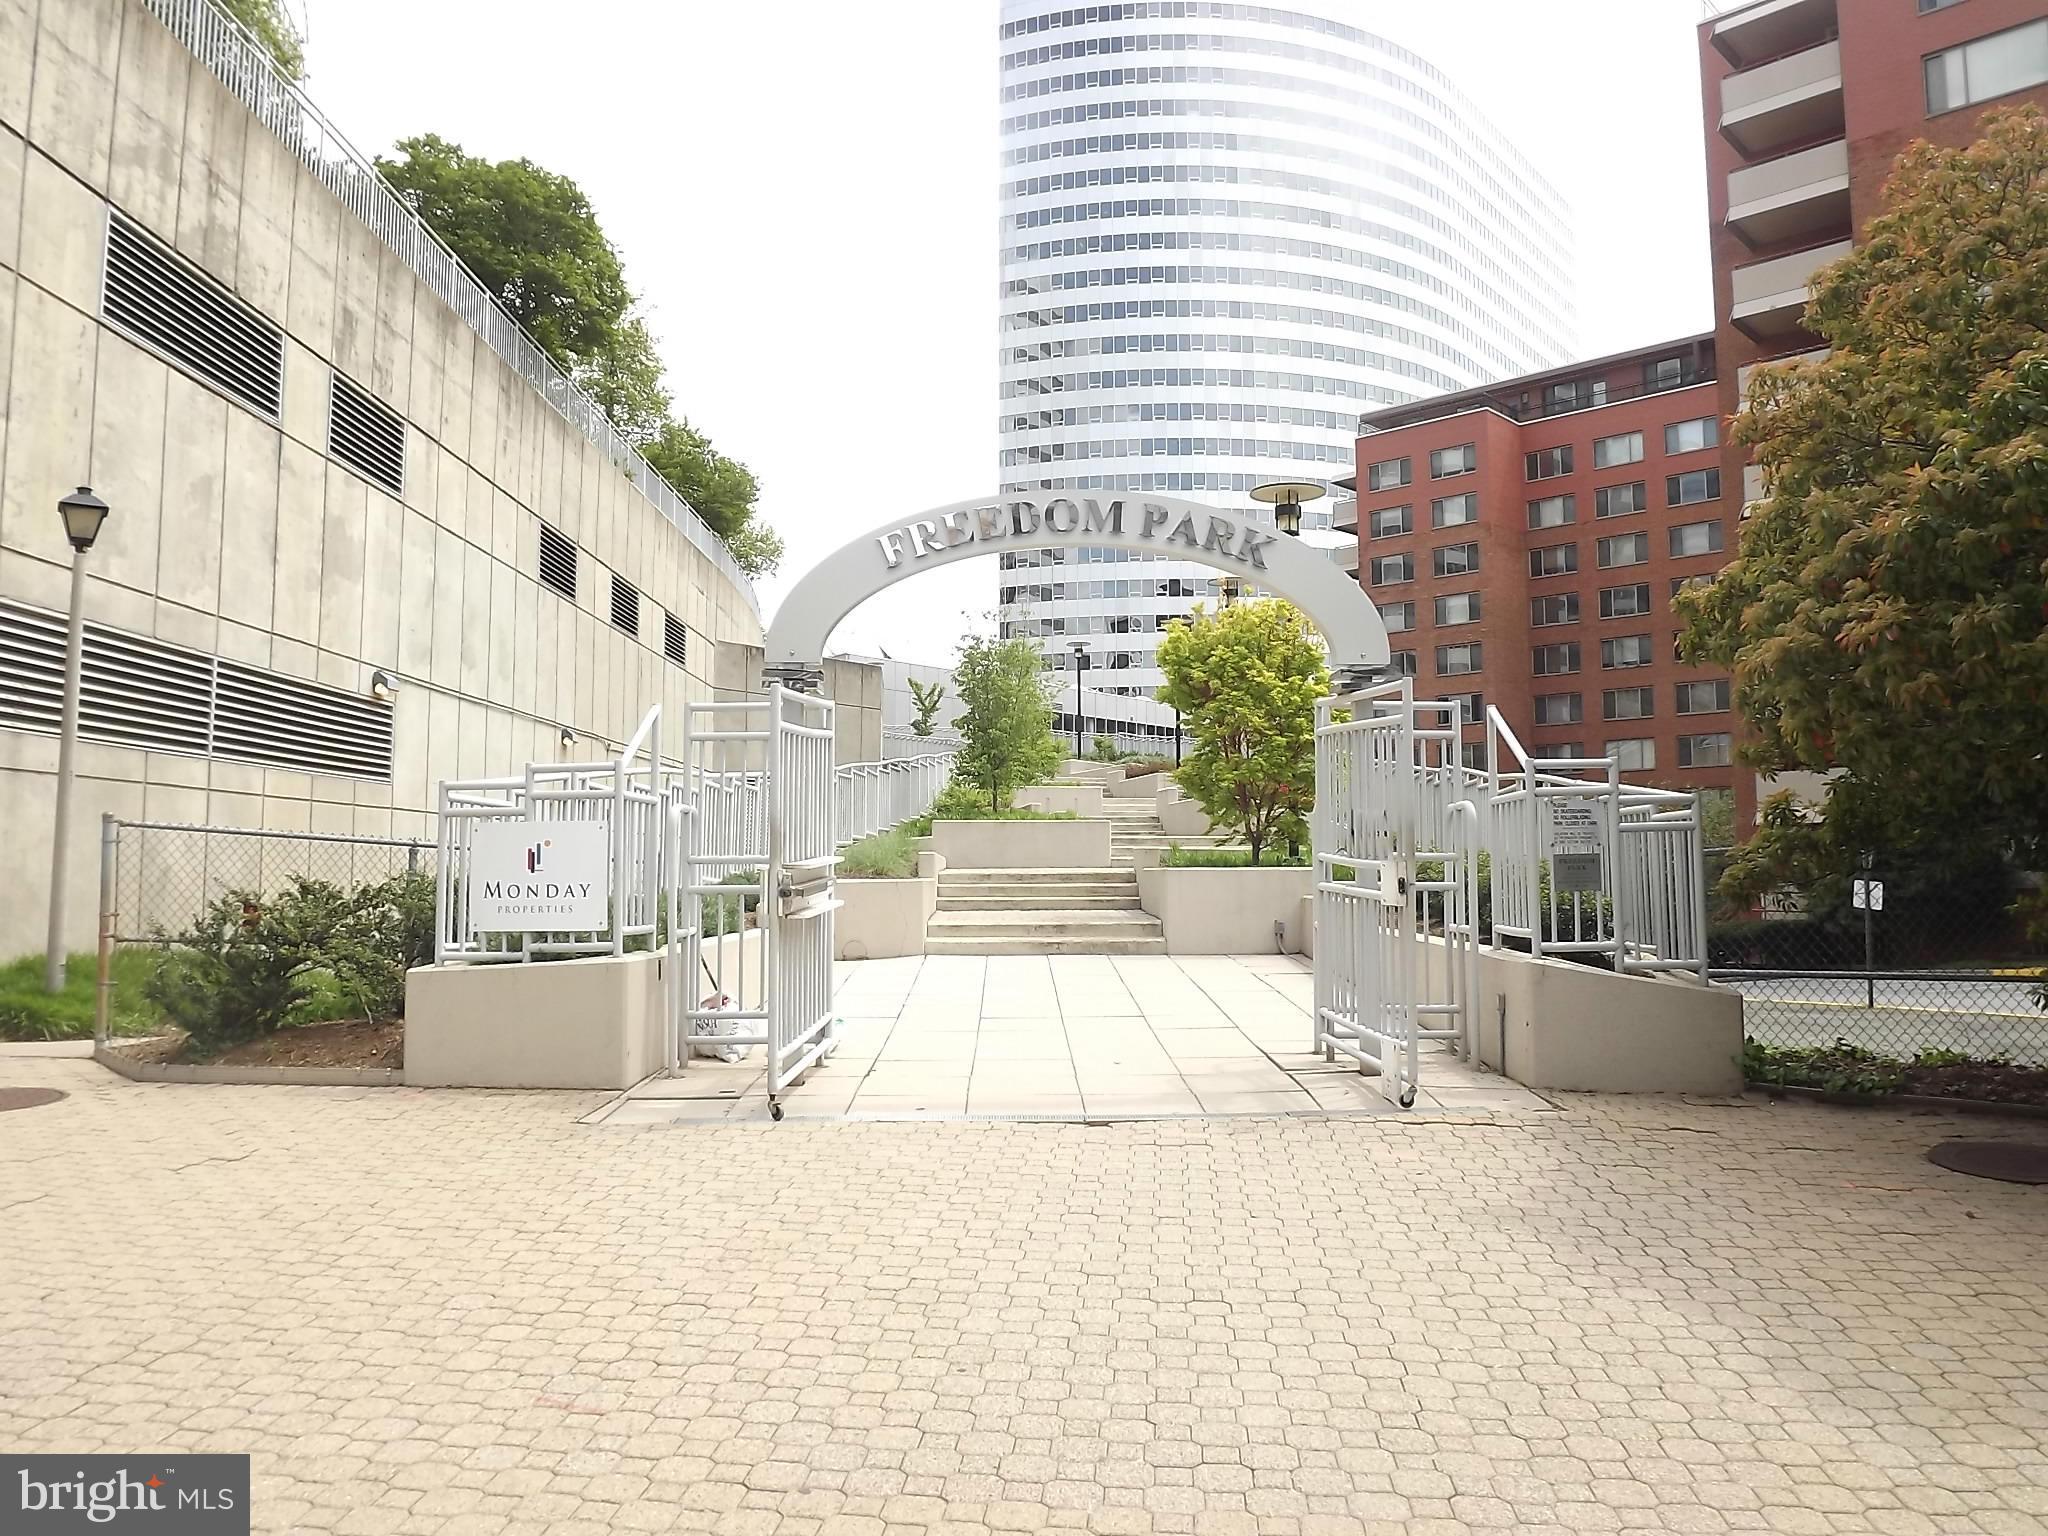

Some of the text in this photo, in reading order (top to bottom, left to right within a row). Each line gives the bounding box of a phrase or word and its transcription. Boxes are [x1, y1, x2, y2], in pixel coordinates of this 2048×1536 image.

[876, 498, 1279, 570] FREEDOM PARK
[484, 881, 592, 899] MONDAY
[497, 904, 574, 914] PROPERTIES
